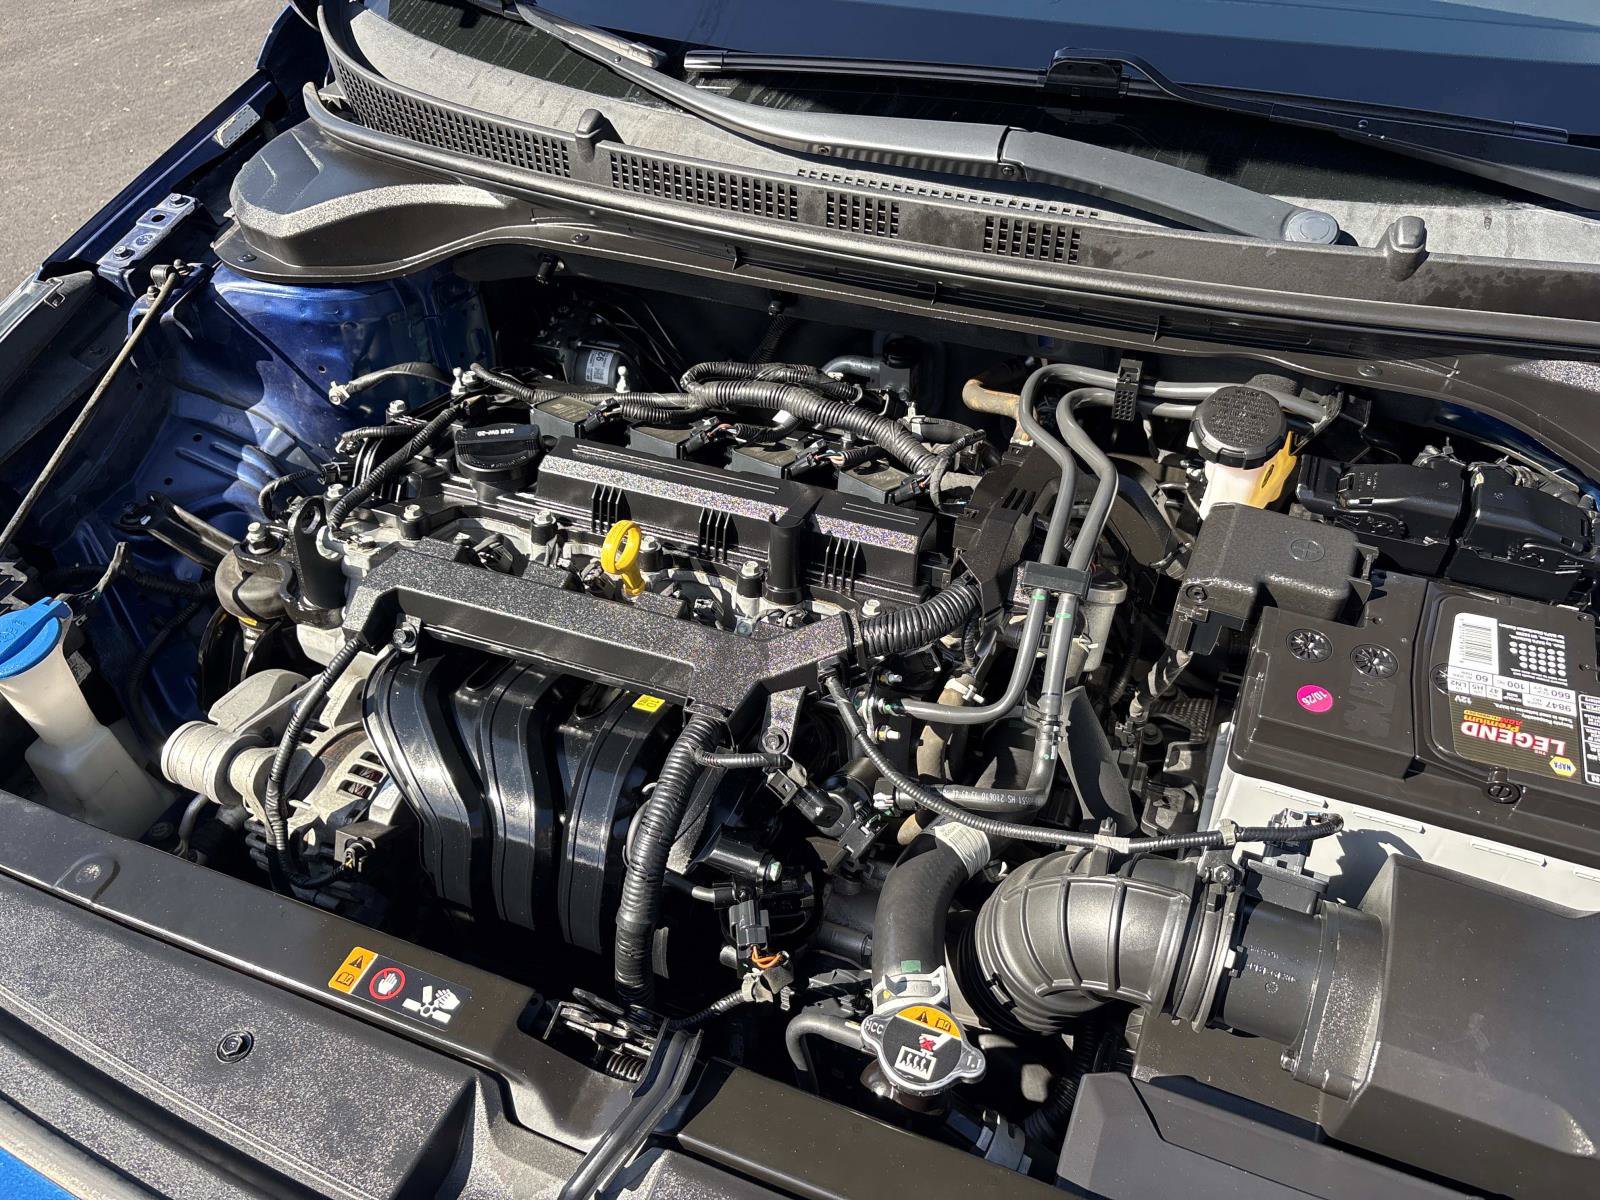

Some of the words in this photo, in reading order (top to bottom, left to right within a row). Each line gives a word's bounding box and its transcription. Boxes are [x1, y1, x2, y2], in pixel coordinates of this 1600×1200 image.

[477, 429, 500, 437] 0W-20
[1507, 682, 1525, 690] 100
[1302, 690, 1328, 705] 10/26
[1552, 690, 1571, 699] 660
[1454, 695, 1472, 704] 12V
[1546, 703, 1572, 712] 9847
[1464, 714, 1520, 732] Premium
[1460, 721, 1566, 756] LEGEND
[1554, 762, 1572, 771] NAPA
[864, 1020, 884, 1034] HCC
